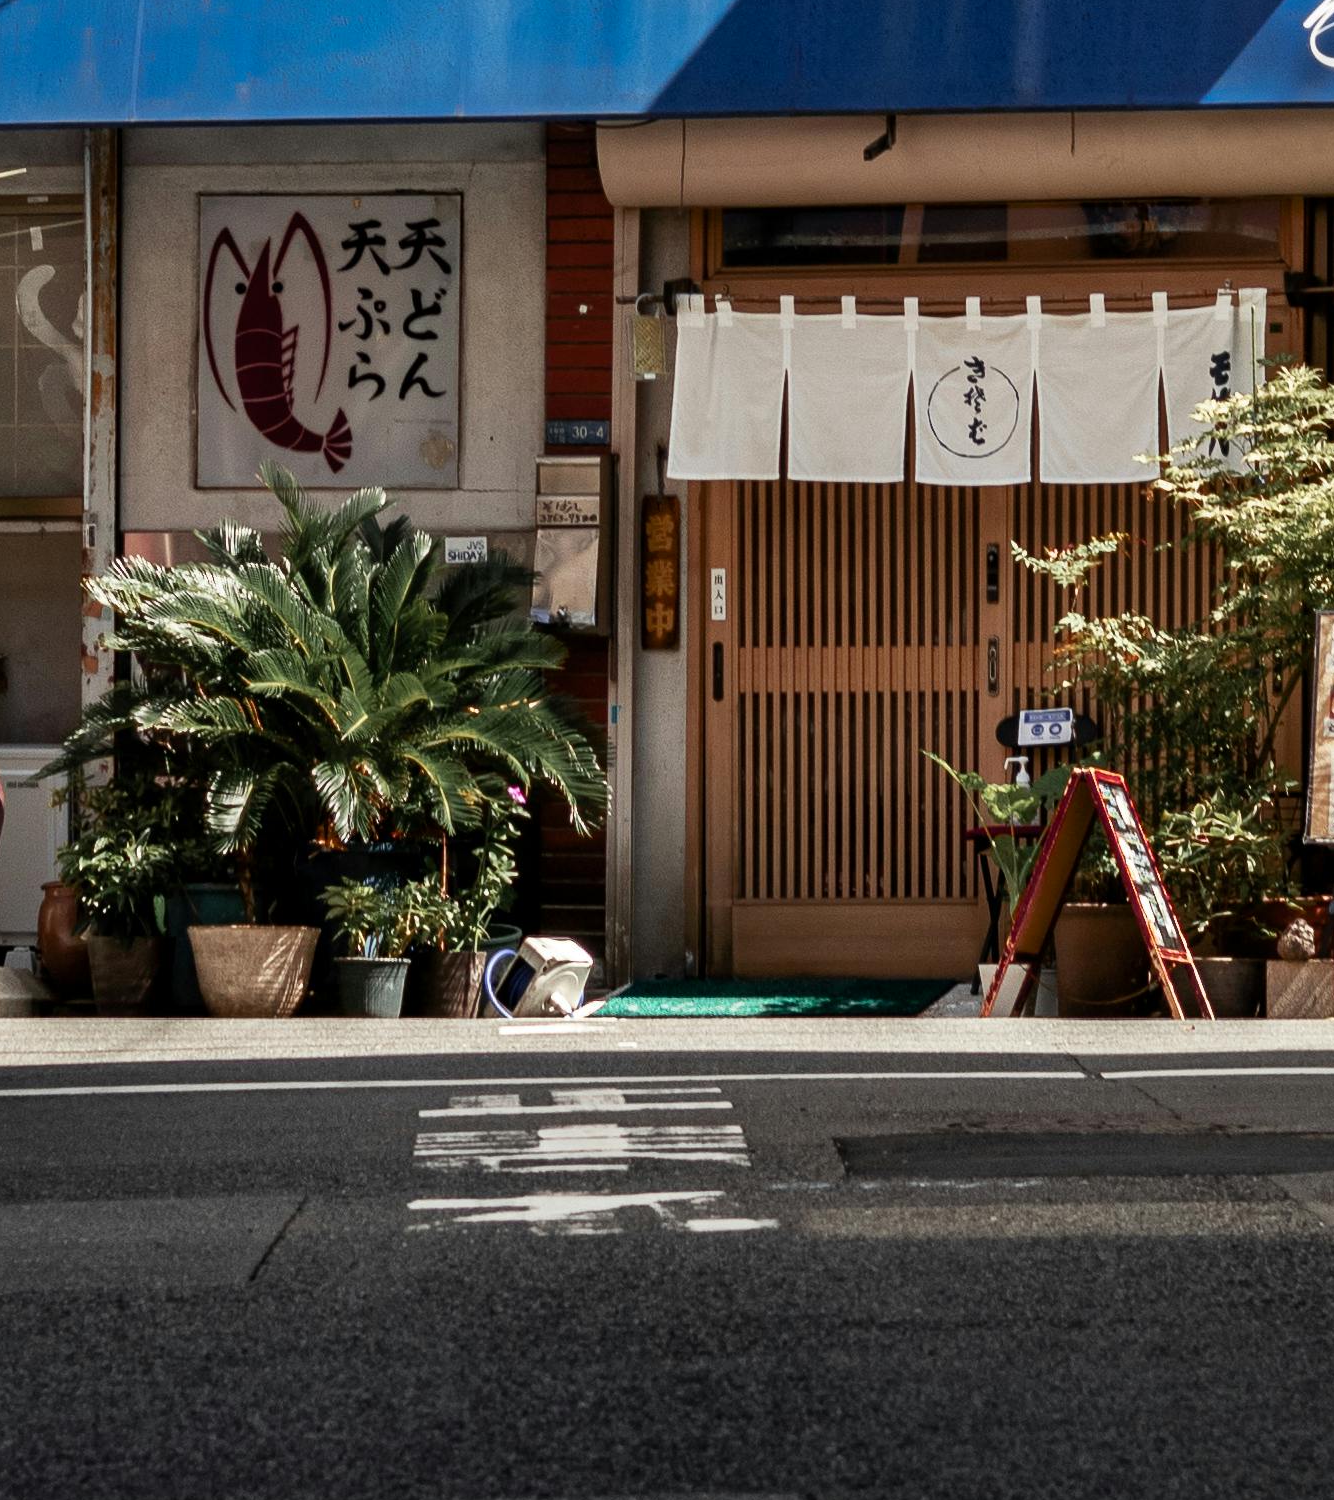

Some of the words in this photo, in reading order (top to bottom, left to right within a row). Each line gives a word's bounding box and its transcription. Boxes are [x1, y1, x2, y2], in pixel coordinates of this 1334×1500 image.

[337, 219, 391, 401] 天ぷら
[391, 218, 452, 401] 天どん
[645, 513, 675, 640] 営業中
[713, 573, 724, 615] 出入口
